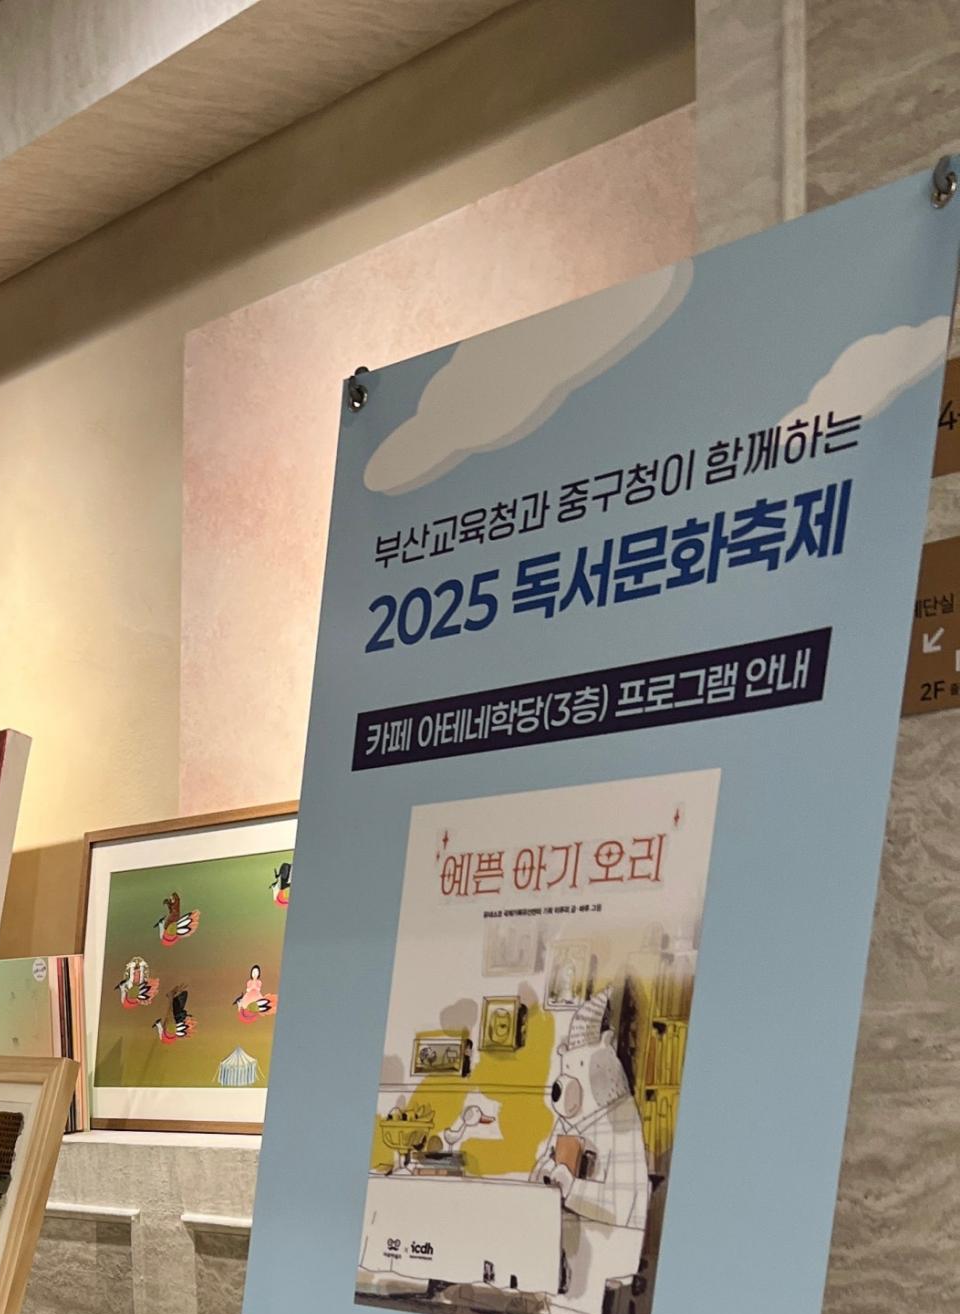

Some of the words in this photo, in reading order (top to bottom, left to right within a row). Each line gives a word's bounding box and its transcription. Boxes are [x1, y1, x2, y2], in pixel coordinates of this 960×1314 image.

[374, 490, 550, 569] 부산교육청과
[558, 449, 695, 523] 중구청이
[705, 411, 863, 482] 함께하는
[365, 569, 500, 653] 2025
[512, 479, 853, 619] 독서문화축제
[915, 593, 954, 618] 단실
[365, 716, 412, 756] 카페
[417, 683, 609, 749] 아테네학당(3층)
[615, 662, 739, 718] 프로그램
[745, 648, 810, 697] 안내
[920, 681, 945, 701] 2F
[440, 850, 505, 896] 예쁜
[512, 841, 583, 891] 아기
[589, 833, 667, 884] 오리
[410, 1241, 433, 1255] icdh
